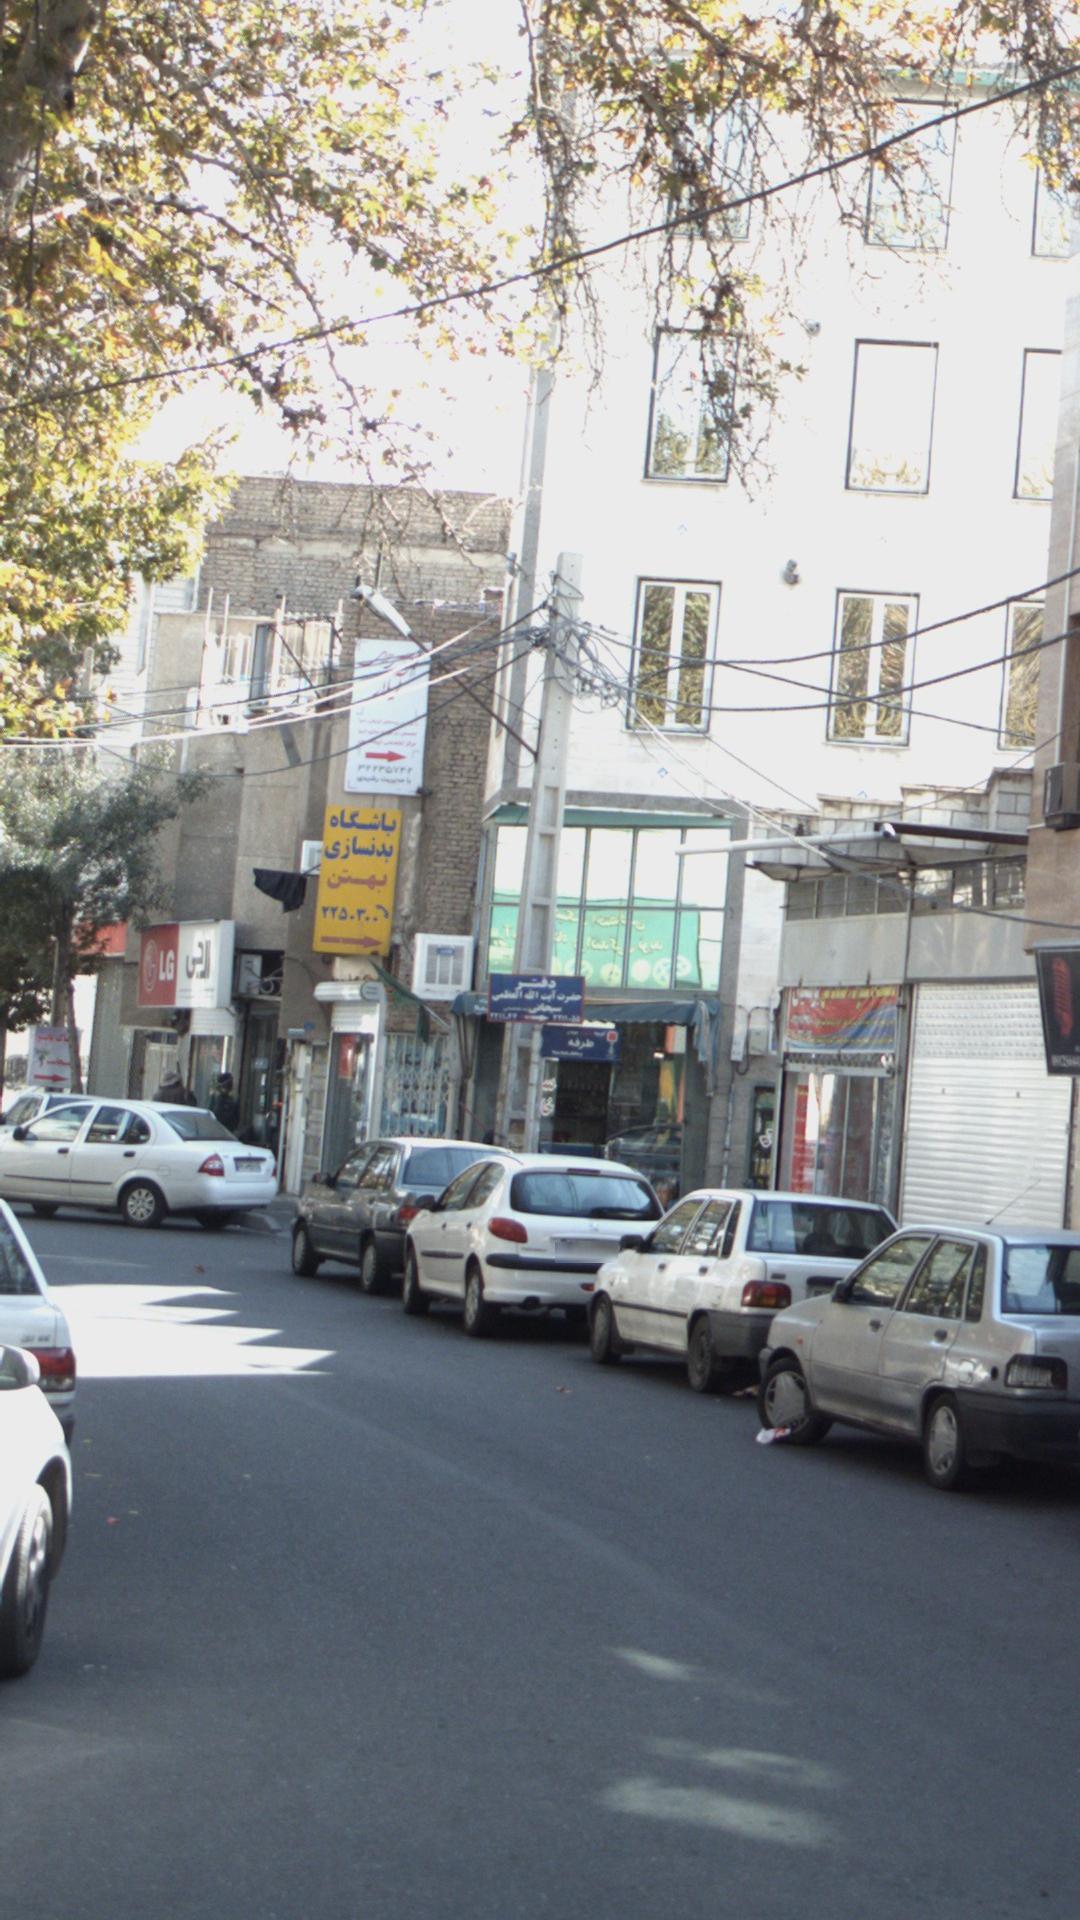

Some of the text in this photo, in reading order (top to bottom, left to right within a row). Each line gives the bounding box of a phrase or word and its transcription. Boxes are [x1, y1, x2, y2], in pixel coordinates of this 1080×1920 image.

[330, 809, 397, 837] باشگاه
[324, 836, 393, 863] بدنسازی
[158, 949, 175, 981] LG
[515, 977, 557, 991] دفتر
[556, 993, 582, 1004] حضرت
